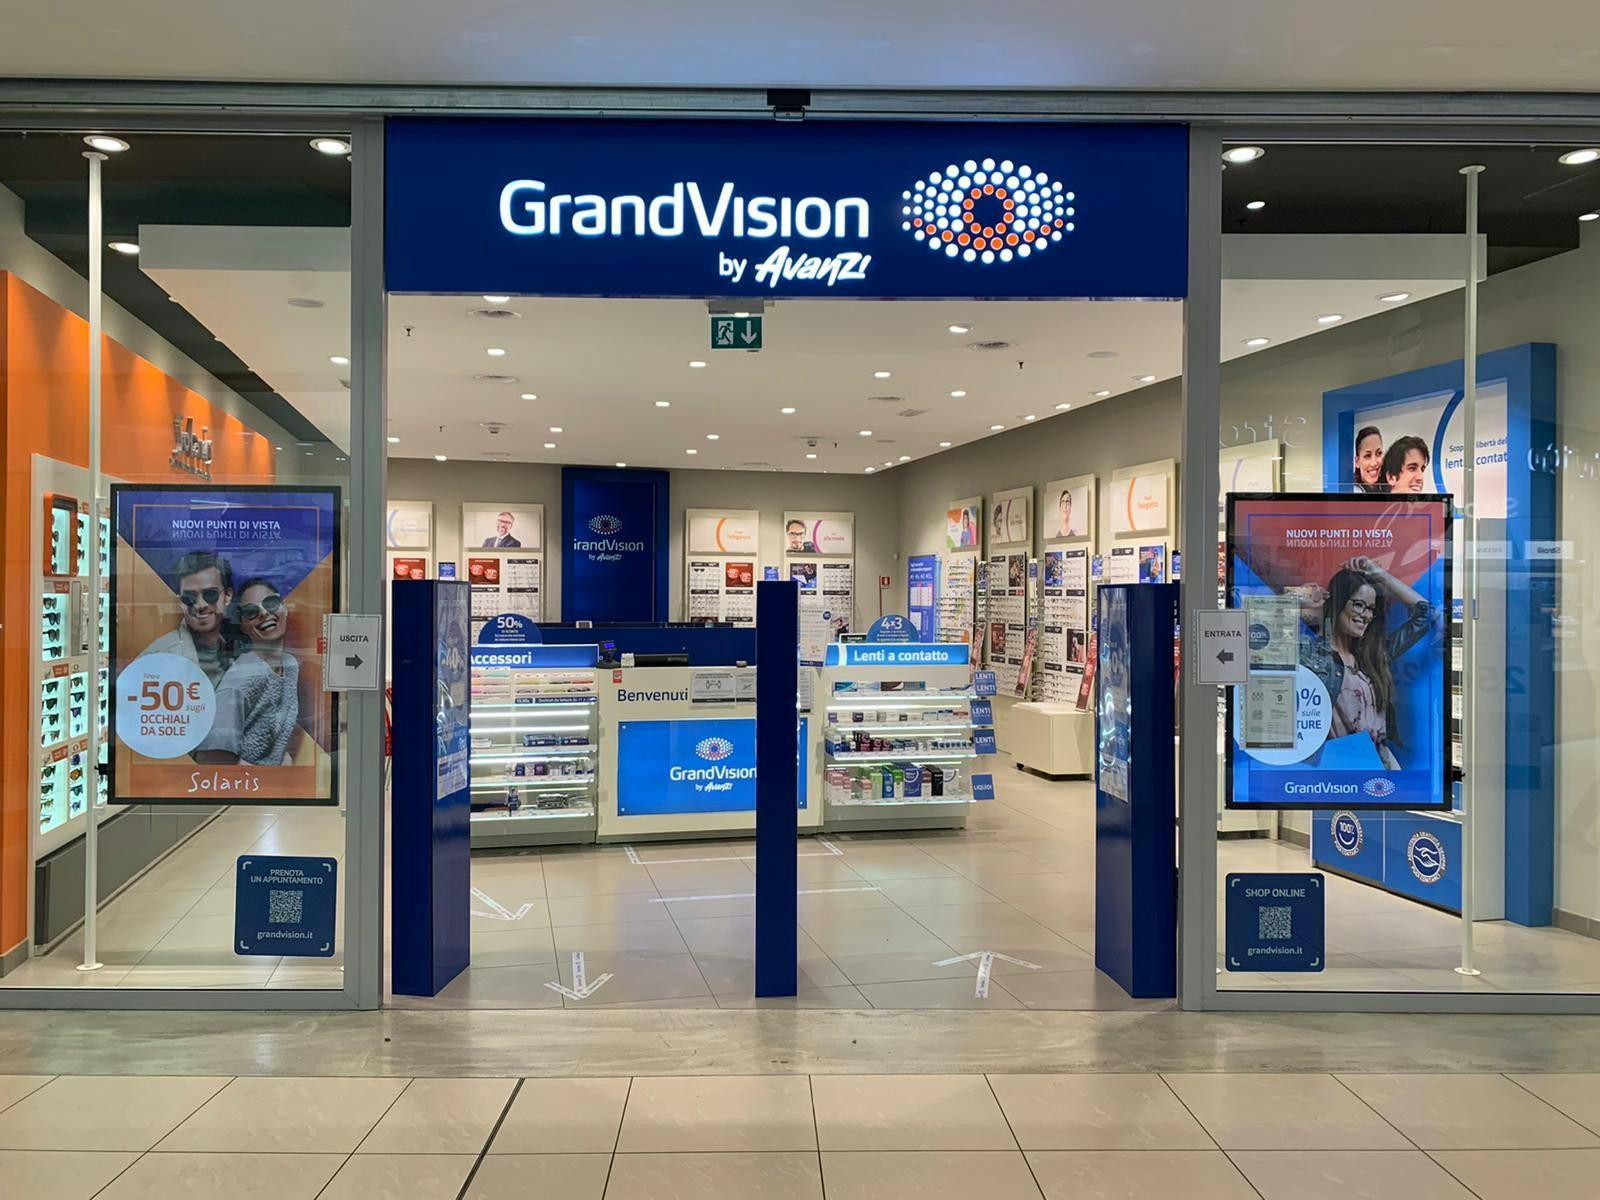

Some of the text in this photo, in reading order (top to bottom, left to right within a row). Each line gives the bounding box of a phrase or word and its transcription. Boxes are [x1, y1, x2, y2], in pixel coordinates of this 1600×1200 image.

[500, 179, 870, 238] GrandVision
[719, 252, 745, 283] by
[1449, 445, 1464, 453] Scop
[1445, 451, 1507, 469] lent contat
[172, 520, 281, 530] NUOVI PUNTI DI VISTA
[1286, 529, 1394, 539] NUOVI PUNTI DI VISTA
[497, 616, 523, 628] 50%
[339, 634, 369, 643] USCITA
[1204, 630, 1242, 638] ENTRATA
[854, 650, 949, 662] Lenti a contatto
[975, 672, 995, 680] LENTI
[617, 688, 689, 702] Benvenuti
[186, 702, 207, 713] sugli
[1301, 708, 1321, 717] sulle
[140, 714, 191, 725] OCCHIALI
[140, 726, 187, 736] DA SOLE
[670, 766, 757, 781] GrandVision
[187, 771, 261, 793] Solaris
[695, 782, 704, 792] by
[1284, 781, 1359, 794] GrandVision
[270, 869, 304, 877] PRENOTA
[251, 876, 324, 885] UN APPUNTAMENTO
[1245, 887, 1306, 898] SHOP ONLINE
[257, 929, 314, 941] grandvision.it
[1246, 945, 1304, 956] grandvision.it
